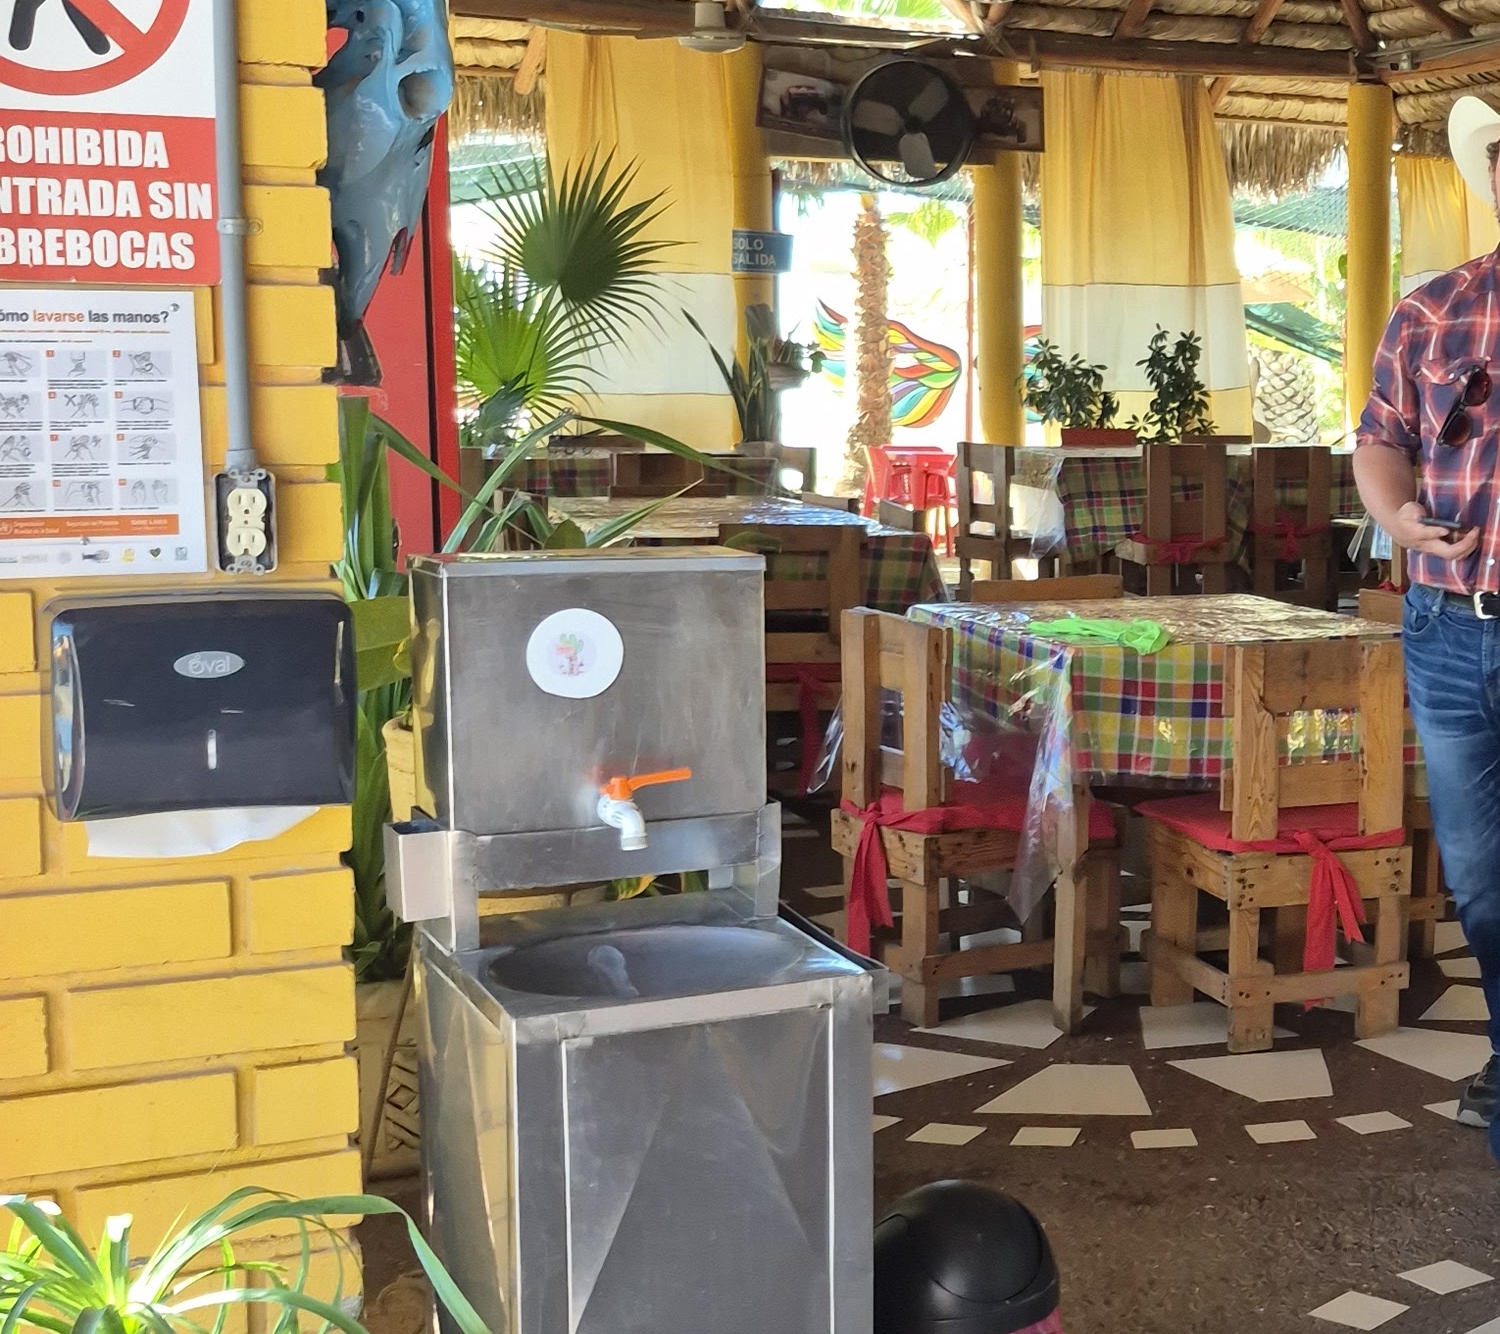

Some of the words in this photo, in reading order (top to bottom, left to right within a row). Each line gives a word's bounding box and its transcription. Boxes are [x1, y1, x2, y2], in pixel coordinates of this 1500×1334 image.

[148, 181, 213, 220] SIN
[734, 238, 764, 251] SOLO
[734, 252, 777, 267] SALIDA
[32, 309, 85, 323] lavarse
[88, 309, 109, 323] las
[112, 310, 169, 324] manos?
